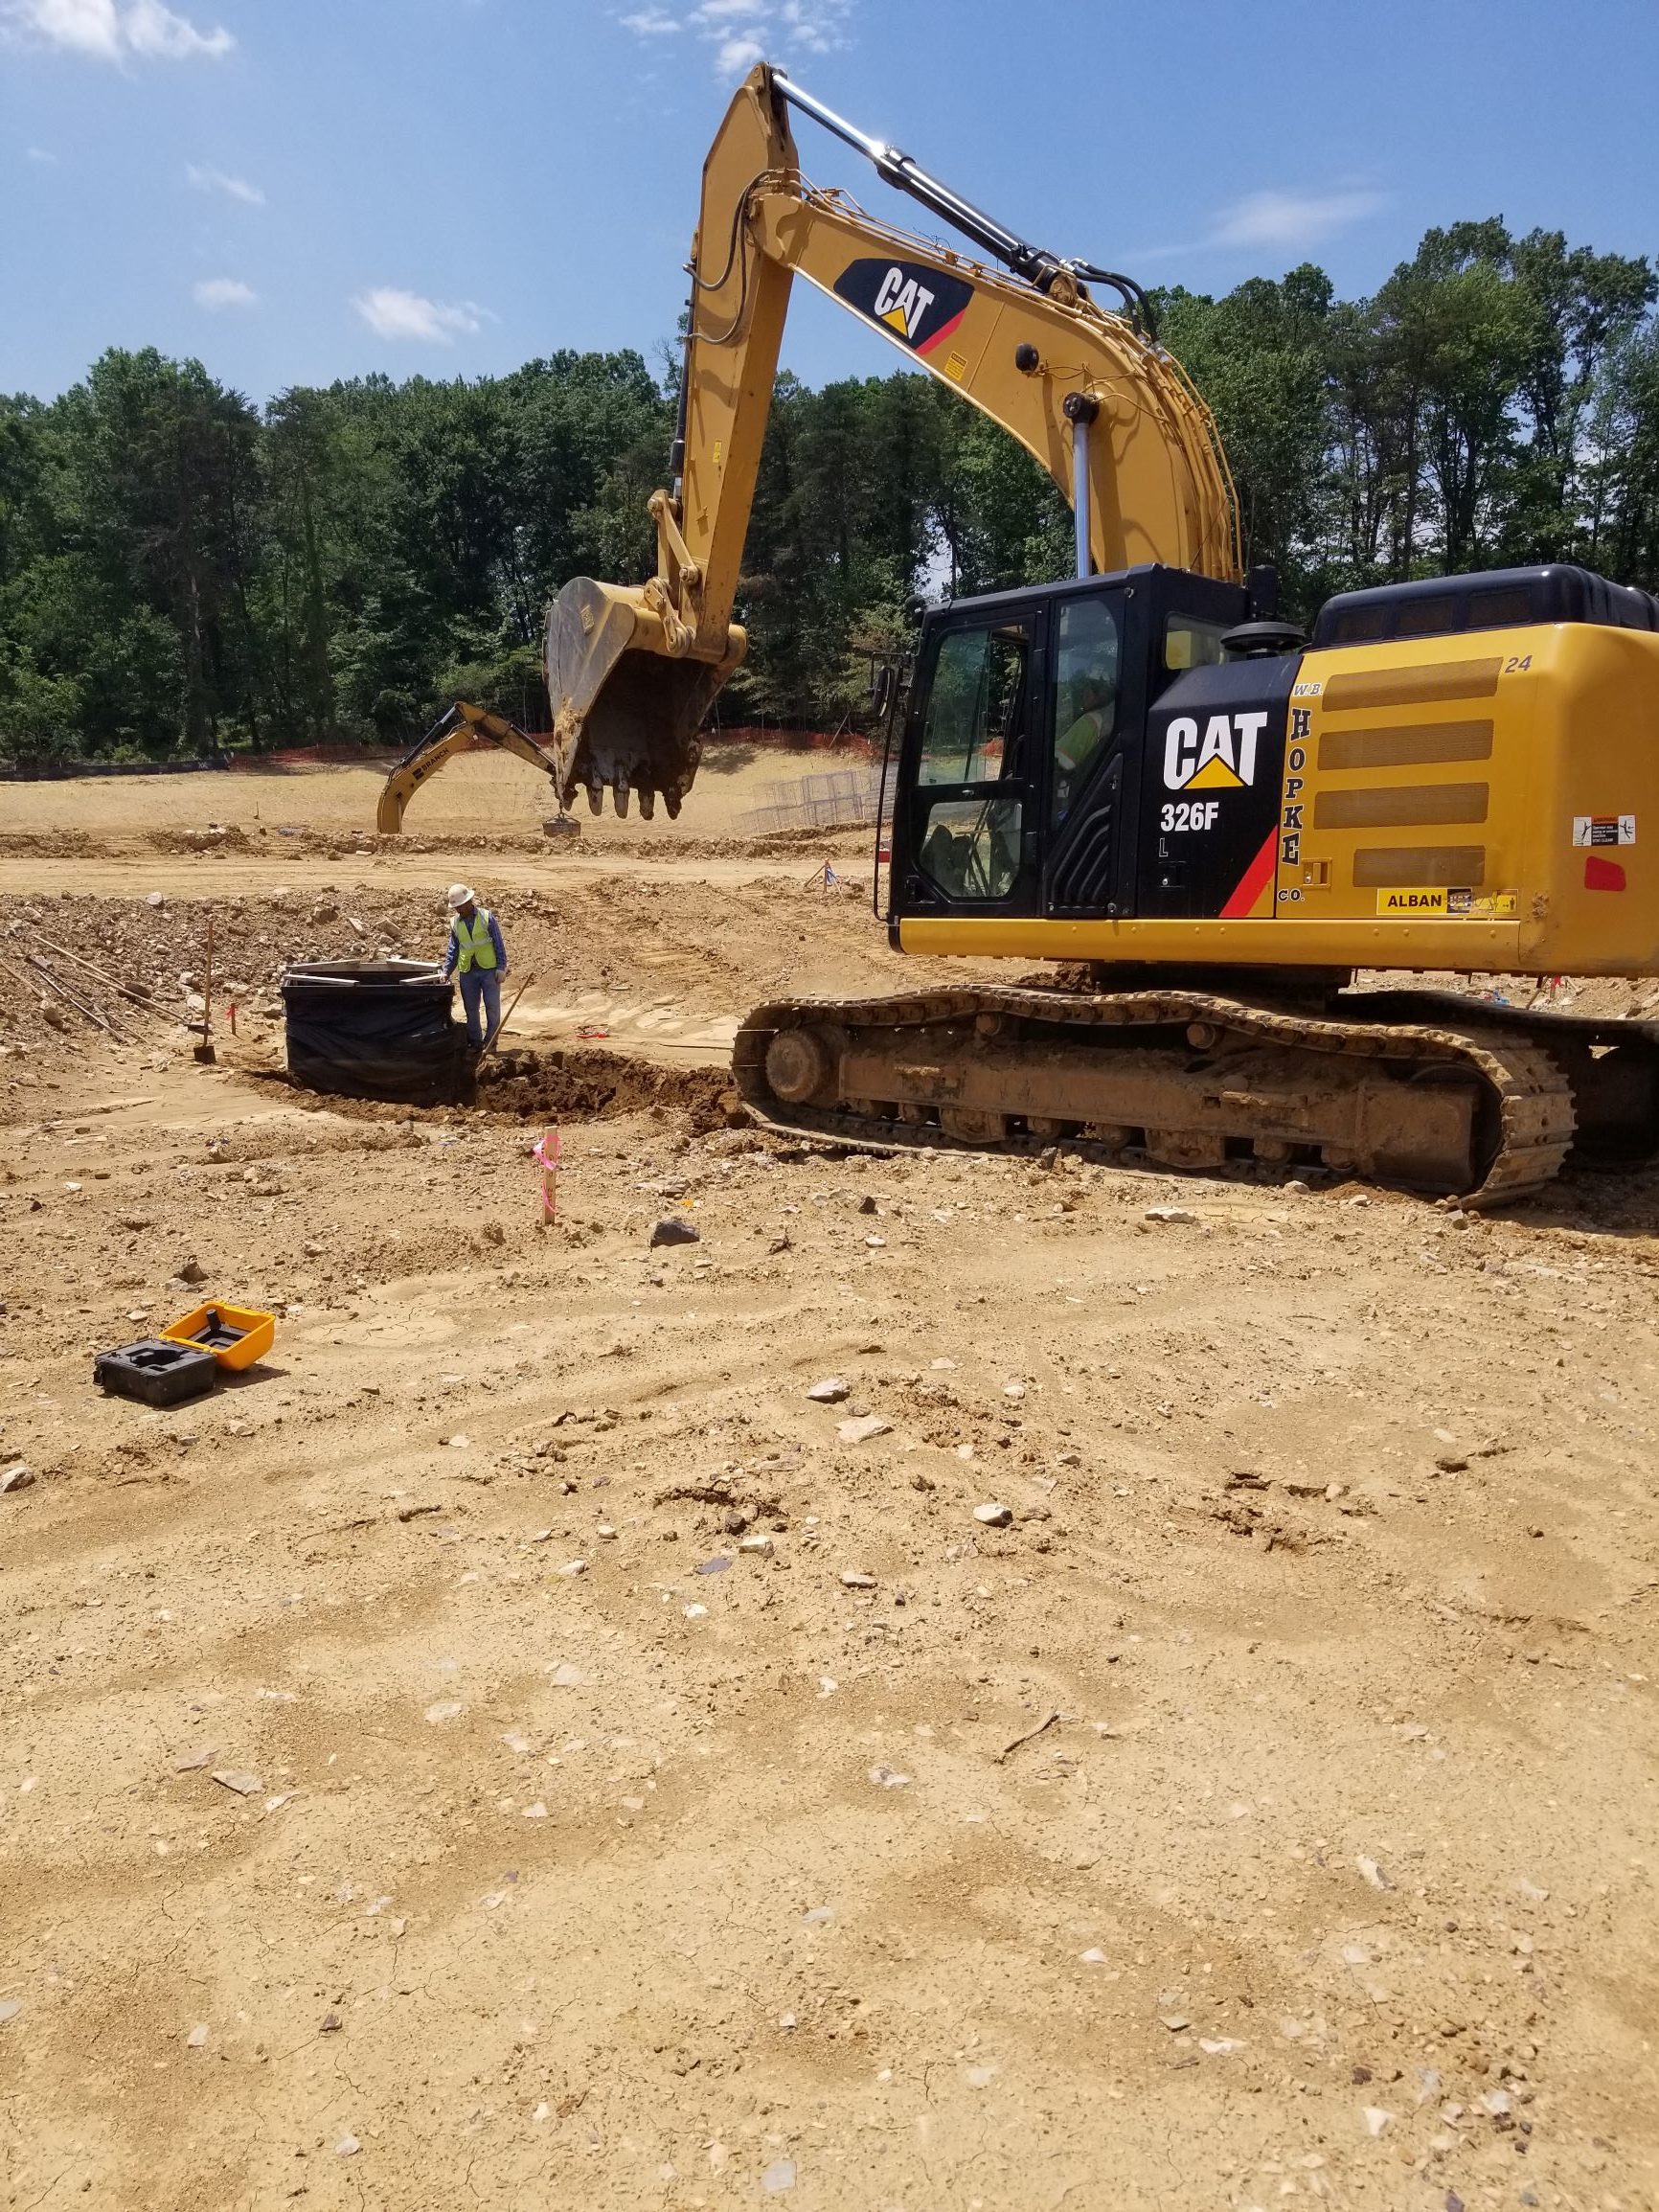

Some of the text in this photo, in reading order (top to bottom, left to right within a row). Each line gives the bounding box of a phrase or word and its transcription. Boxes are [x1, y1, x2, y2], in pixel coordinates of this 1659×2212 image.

[875, 267, 935, 339] CAT
[1505, 655, 1533, 673] 24
[421, 748, 449, 771] BRANCH
[1164, 712, 1267, 789] CAT
[1282, 707, 1311, 866] HOPKE
[1161, 802, 1218, 832] 326F
[1159, 838, 1169, 856] L
[1278, 888, 1305, 902] CO.
[1388, 895, 1443, 907] ALBAN
